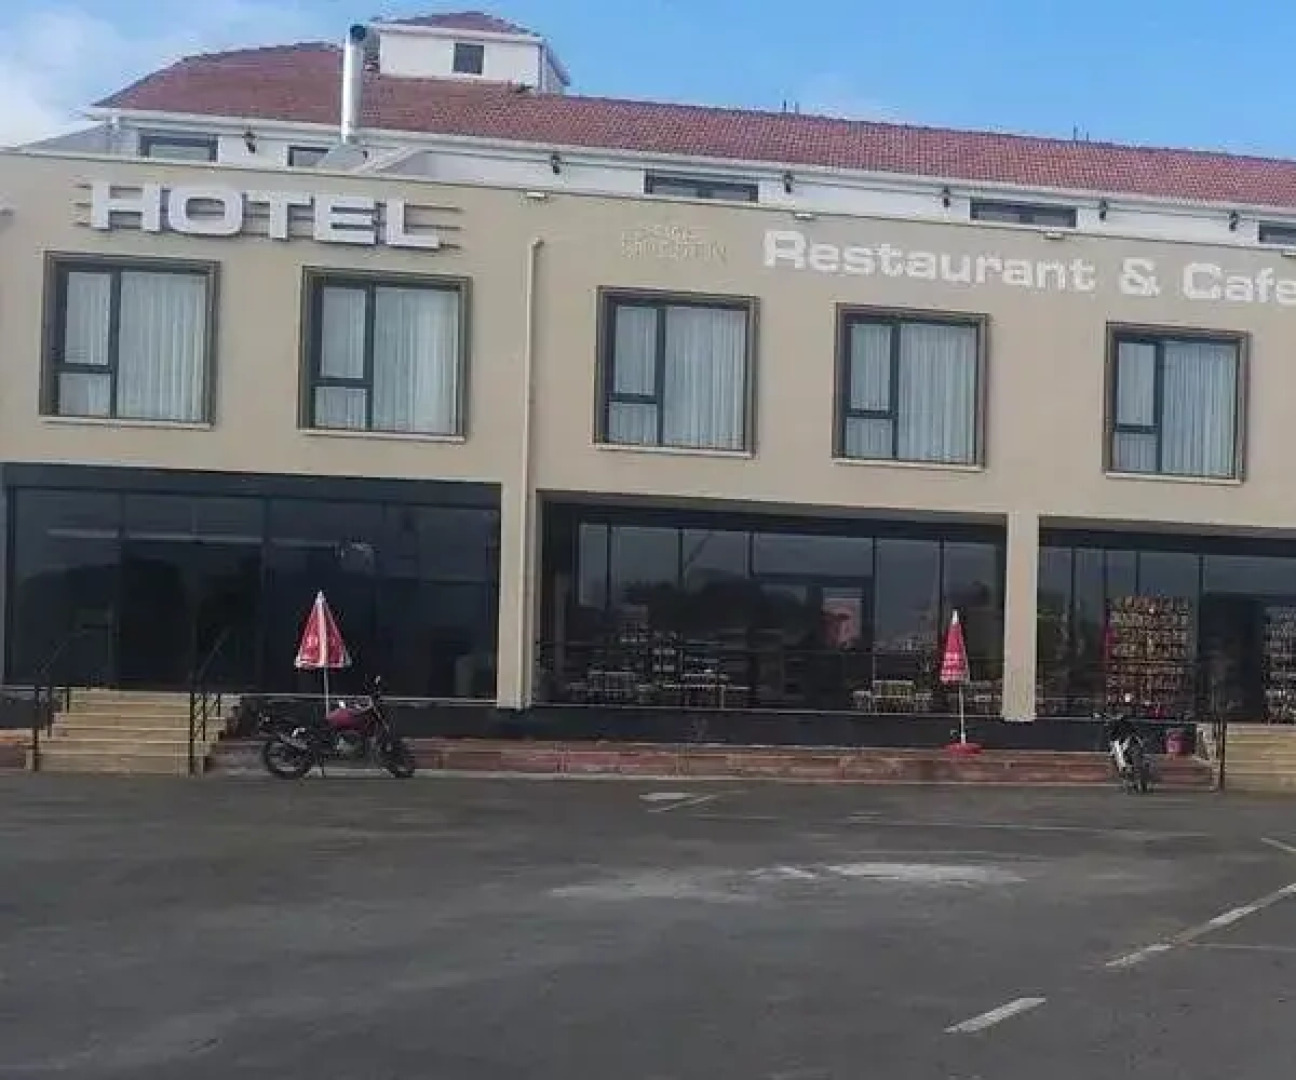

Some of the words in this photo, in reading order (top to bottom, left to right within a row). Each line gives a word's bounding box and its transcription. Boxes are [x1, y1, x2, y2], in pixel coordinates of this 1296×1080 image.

[90, 181, 440, 250] HOTEL
[763, 230, 1096, 293] Restaurant
[1119, 258, 1161, 298] &
